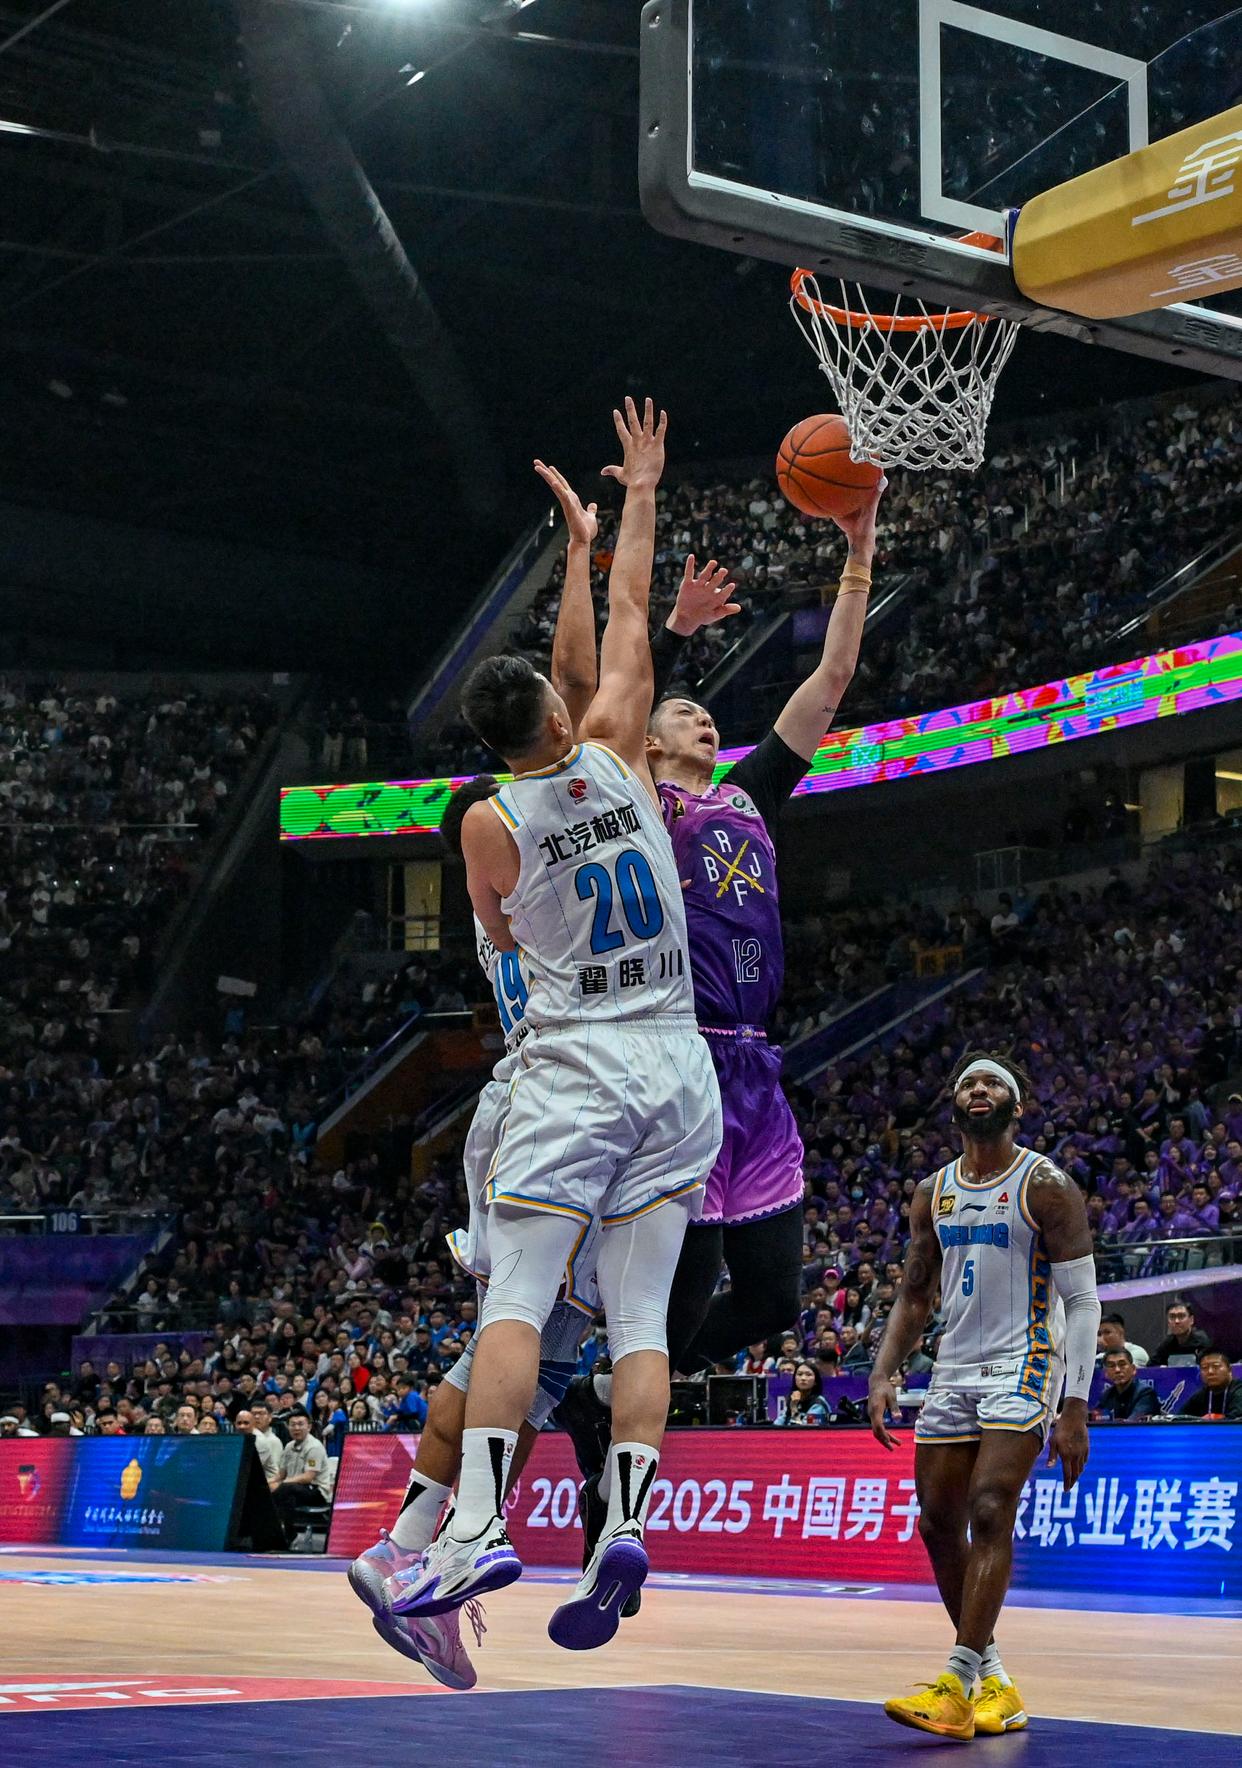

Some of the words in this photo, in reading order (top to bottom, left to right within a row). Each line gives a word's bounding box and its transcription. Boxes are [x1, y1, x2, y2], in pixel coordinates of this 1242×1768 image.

[538, 803, 641, 867] 北汽极狐
[713, 830, 731, 854] R
[705, 856, 719, 883] B
[750, 854, 762, 878] J
[574, 849, 664, 955] 20
[733, 879, 748, 907] F
[579, 949, 682, 995] 翟晓川
[732, 938, 761, 984] 12
[51, 1212, 78, 1232] 106
[961, 1259, 975, 1297] 5
[763, 1475, 1239, 1552] 中国男子职业联赛
